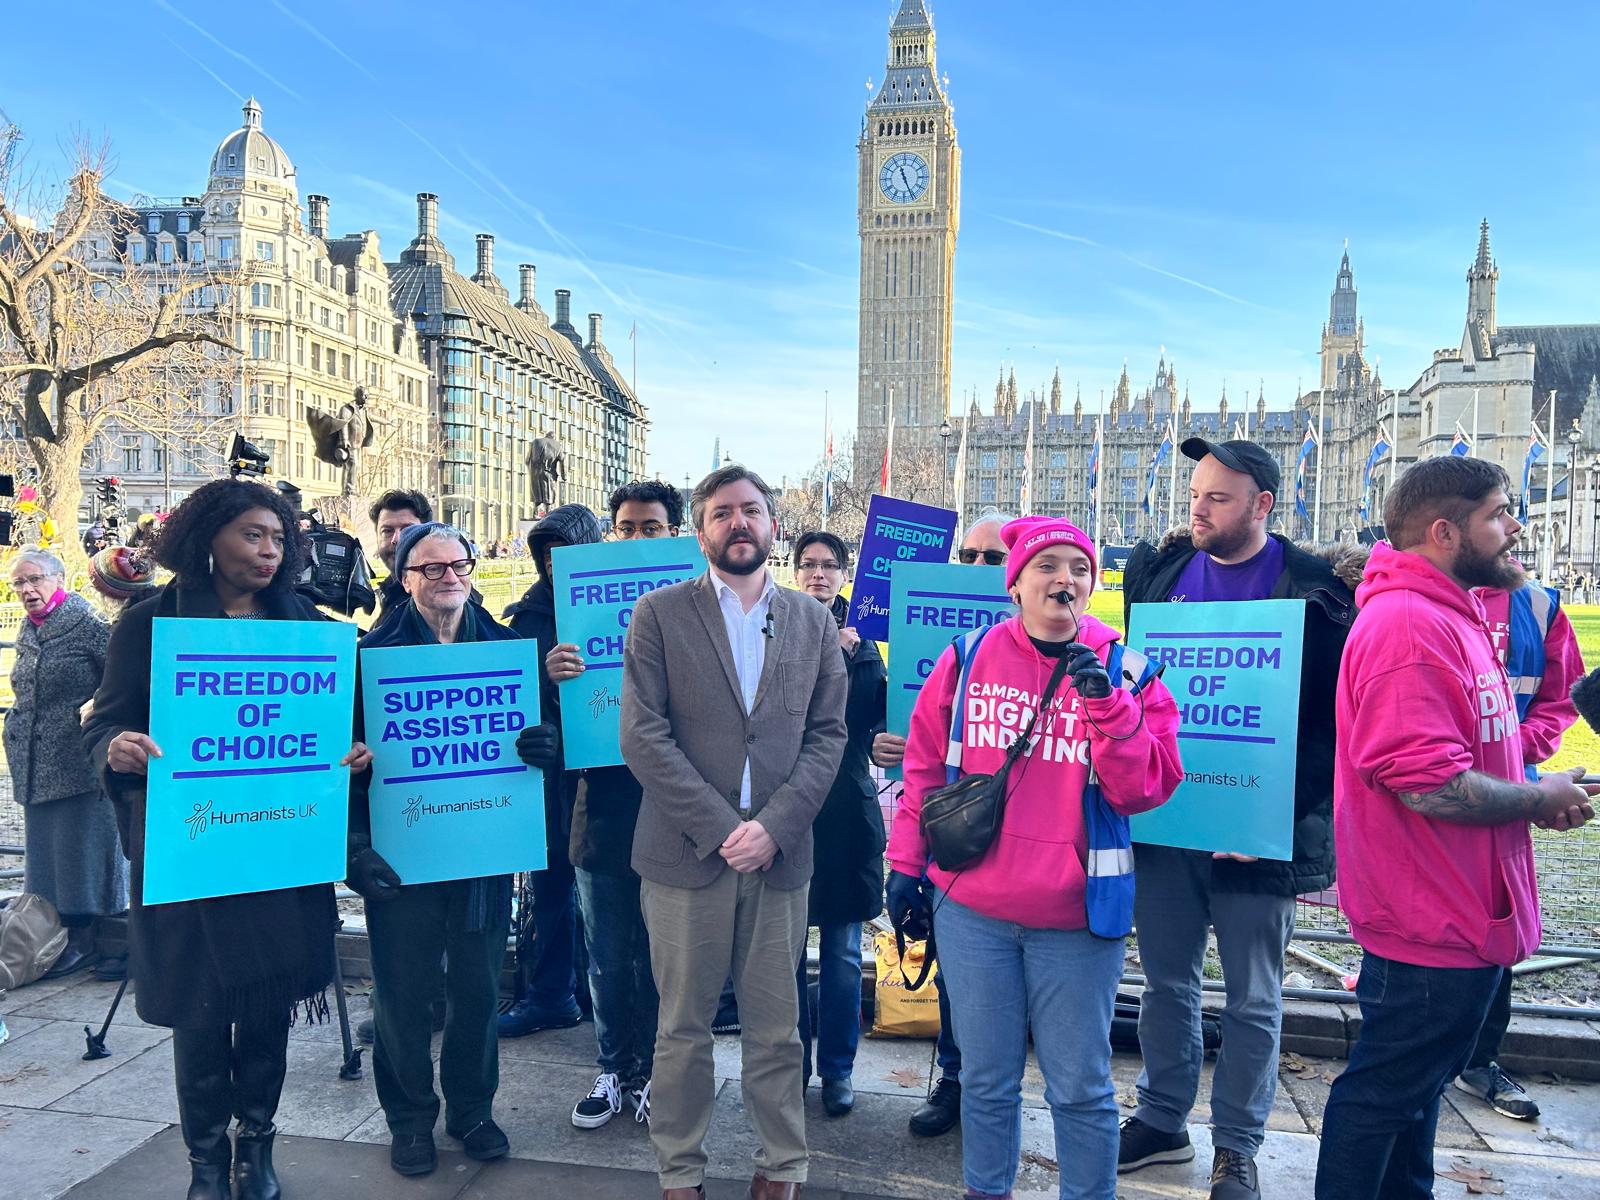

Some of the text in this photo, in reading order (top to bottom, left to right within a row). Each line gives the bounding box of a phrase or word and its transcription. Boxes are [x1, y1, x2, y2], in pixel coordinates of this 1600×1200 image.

[874, 524, 944, 548] FREEDOM
[897, 544, 918, 560] OF
[570, 578, 695, 607] FREED
[1143, 646, 1281, 670] FREEDOM
[175, 671, 336, 696] FREEDOM
[968, 682, 1063, 710] CAMPAIN
[1188, 675, 1227, 697] OF
[384, 683, 522, 713] SUPPORT
[237, 703, 282, 728] OF
[381, 711, 525, 742] ASSISTED
[967, 697, 1079, 737] DIGNIT
[191, 733, 318, 762] CHOICE
[411, 739, 501, 768] DYING
[1184, 770, 1262, 789] manists UK
[210, 802, 319, 825] Humanists UK
[421, 795, 513, 818] Humanists UK
